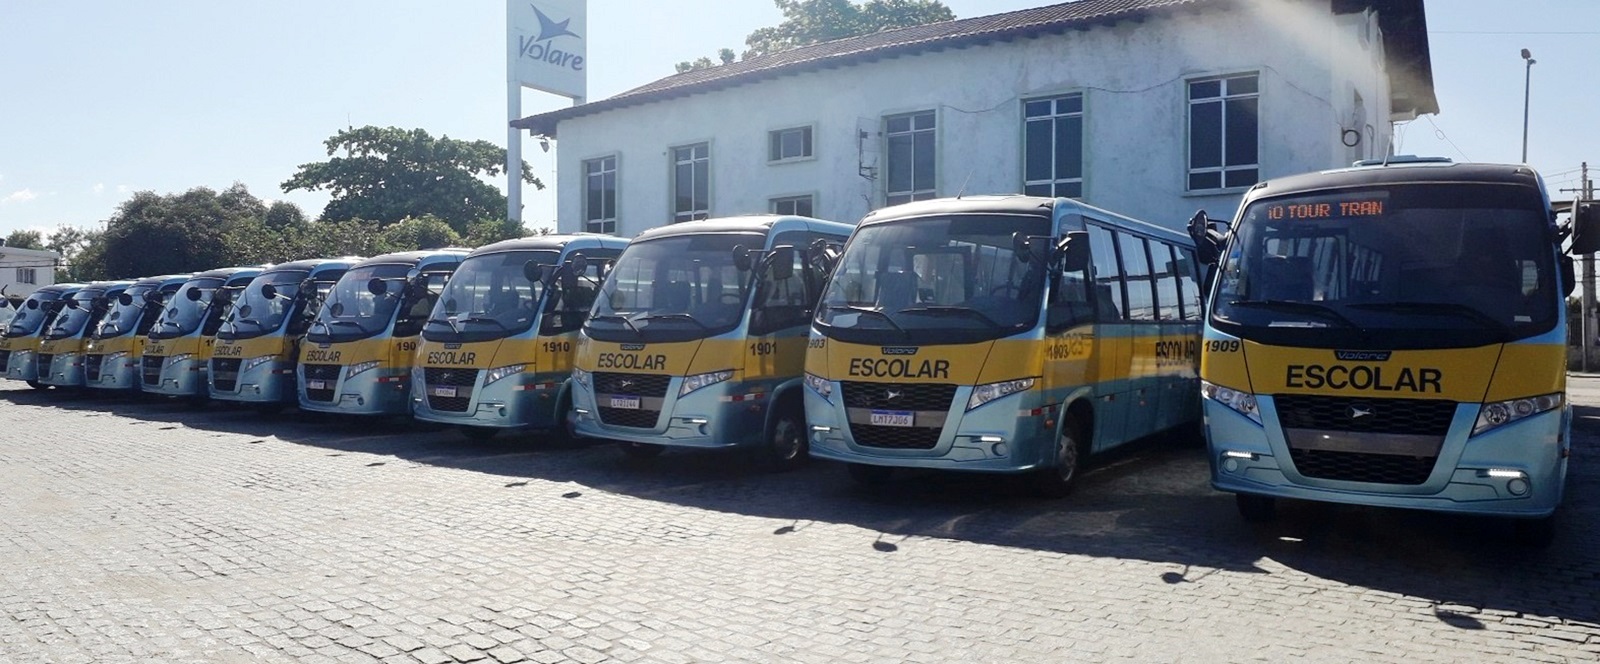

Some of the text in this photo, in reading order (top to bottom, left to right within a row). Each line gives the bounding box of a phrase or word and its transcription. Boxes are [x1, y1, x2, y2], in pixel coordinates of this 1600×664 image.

[519, 35, 583, 71] Volare
[1287, 203, 1330, 219] TOUR
[1339, 200, 1383, 217] TRAN
[396, 341, 417, 352] 190
[543, 341, 570, 353] 1910
[750, 342, 777, 356] 1901
[1048, 343, 1069, 359] 1903
[1155, 340, 1195, 361] ESCOLAR
[1204, 339, 1239, 353] 1909
[306, 350, 341, 363] ESCOLAR
[427, 351, 475, 365] ESCOLAR
[597, 353, 666, 370] ESCOLAR
[1337, 351, 1388, 361] Volare
[849, 358, 949, 379] ESCOLAR
[1286, 364, 1441, 393] ESCOLAR
